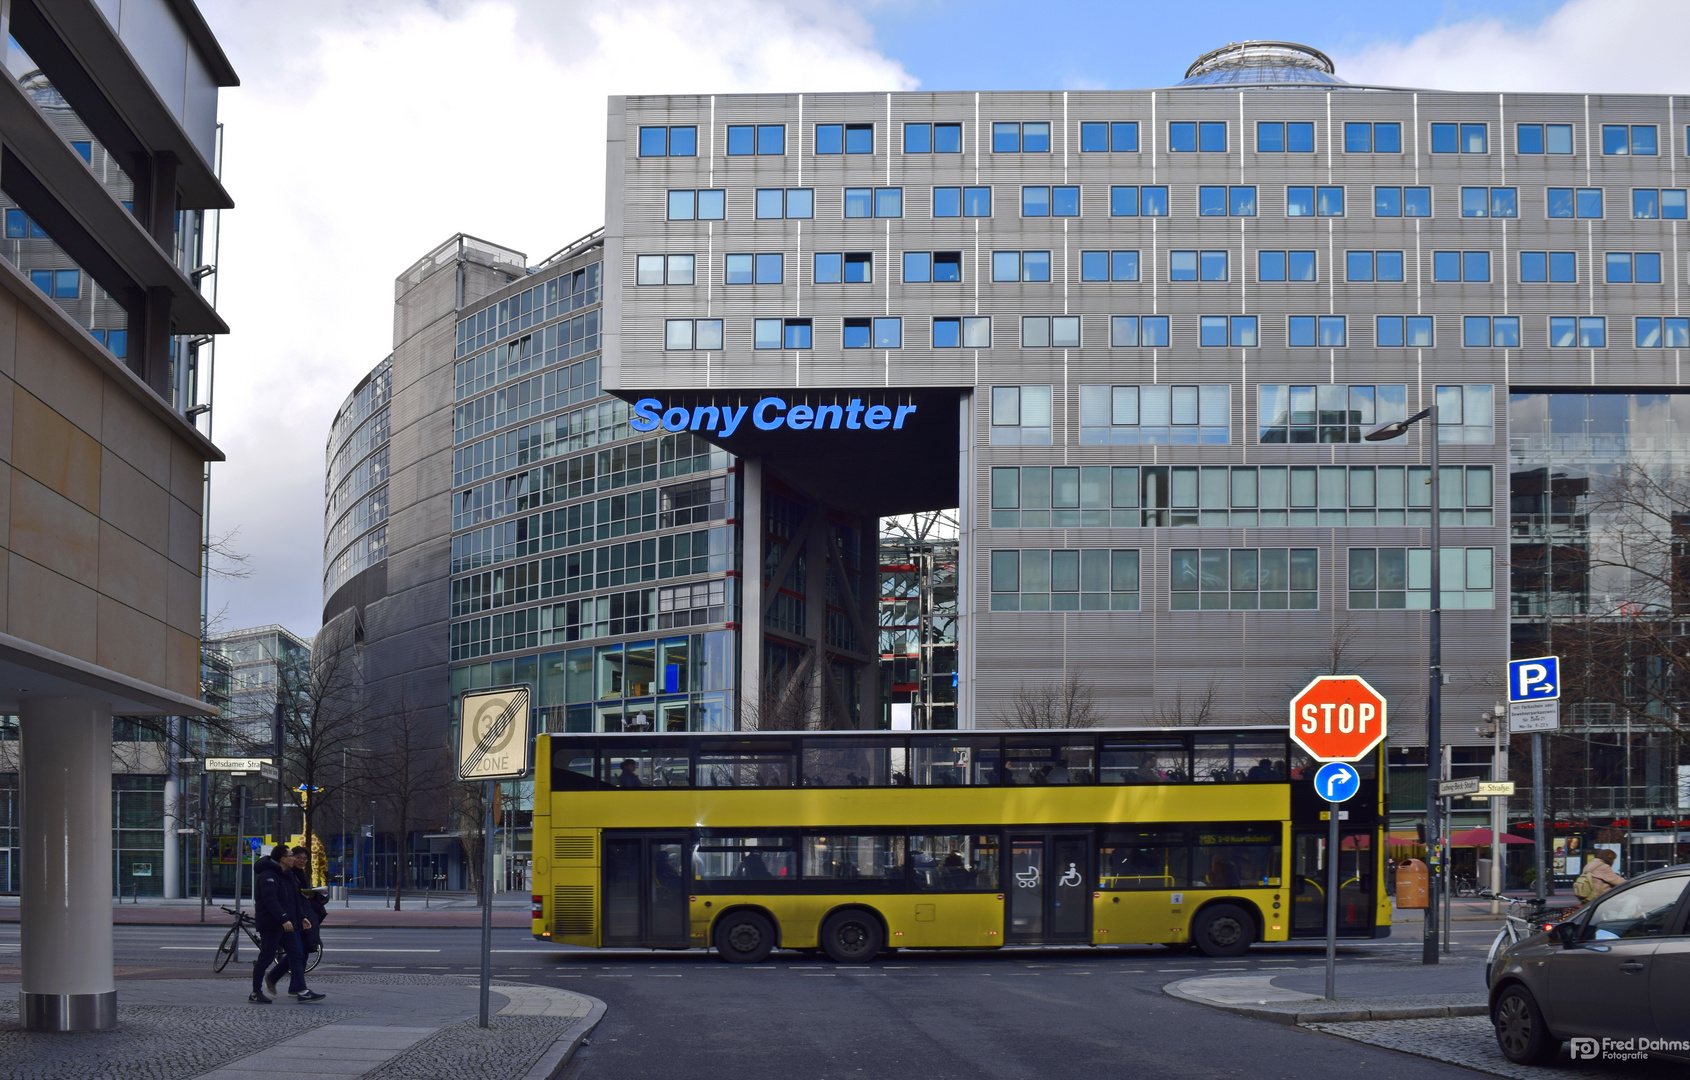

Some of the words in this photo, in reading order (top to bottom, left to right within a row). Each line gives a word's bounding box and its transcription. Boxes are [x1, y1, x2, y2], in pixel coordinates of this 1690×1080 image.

[630, 397, 749, 438] Sony
[752, 396, 917, 431] Center
[1519, 663, 1547, 697] P
[1301, 703, 1376, 734] STOP
[209, 760, 245, 768] Potsdamer
[475, 756, 509, 772] ZONE
